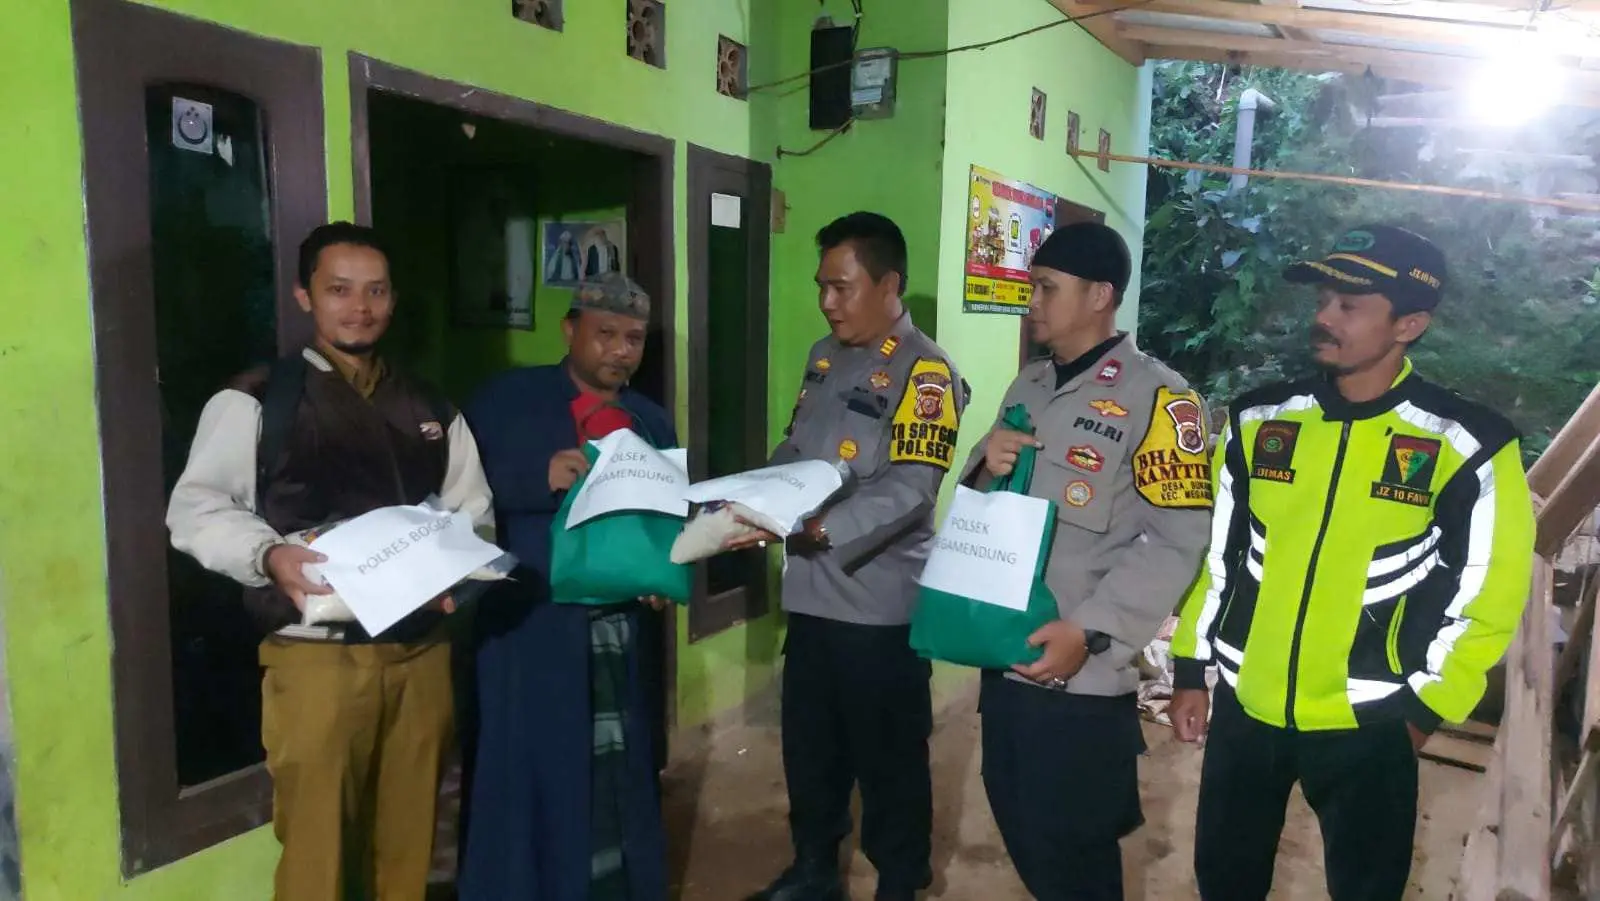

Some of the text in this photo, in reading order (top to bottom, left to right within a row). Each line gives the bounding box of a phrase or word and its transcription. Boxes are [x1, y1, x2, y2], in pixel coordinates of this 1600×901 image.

[1073, 416, 1124, 443] POLRI
[610, 451, 648, 464] OLSEK
[897, 439, 951, 462] POLSEK
[1137, 448, 1182, 469] BHA
[593, 468, 675, 485] GAMENDUNG
[1256, 467, 1292, 481] DIMAS
[1376, 486, 1391, 497] JZ
[1393, 489, 1405, 500] 10
[951, 516, 990, 535] POLSEK
[358, 516, 454, 576] POLRES BOGOR
[935, 537, 1018, 566] EGAMENDUNG
